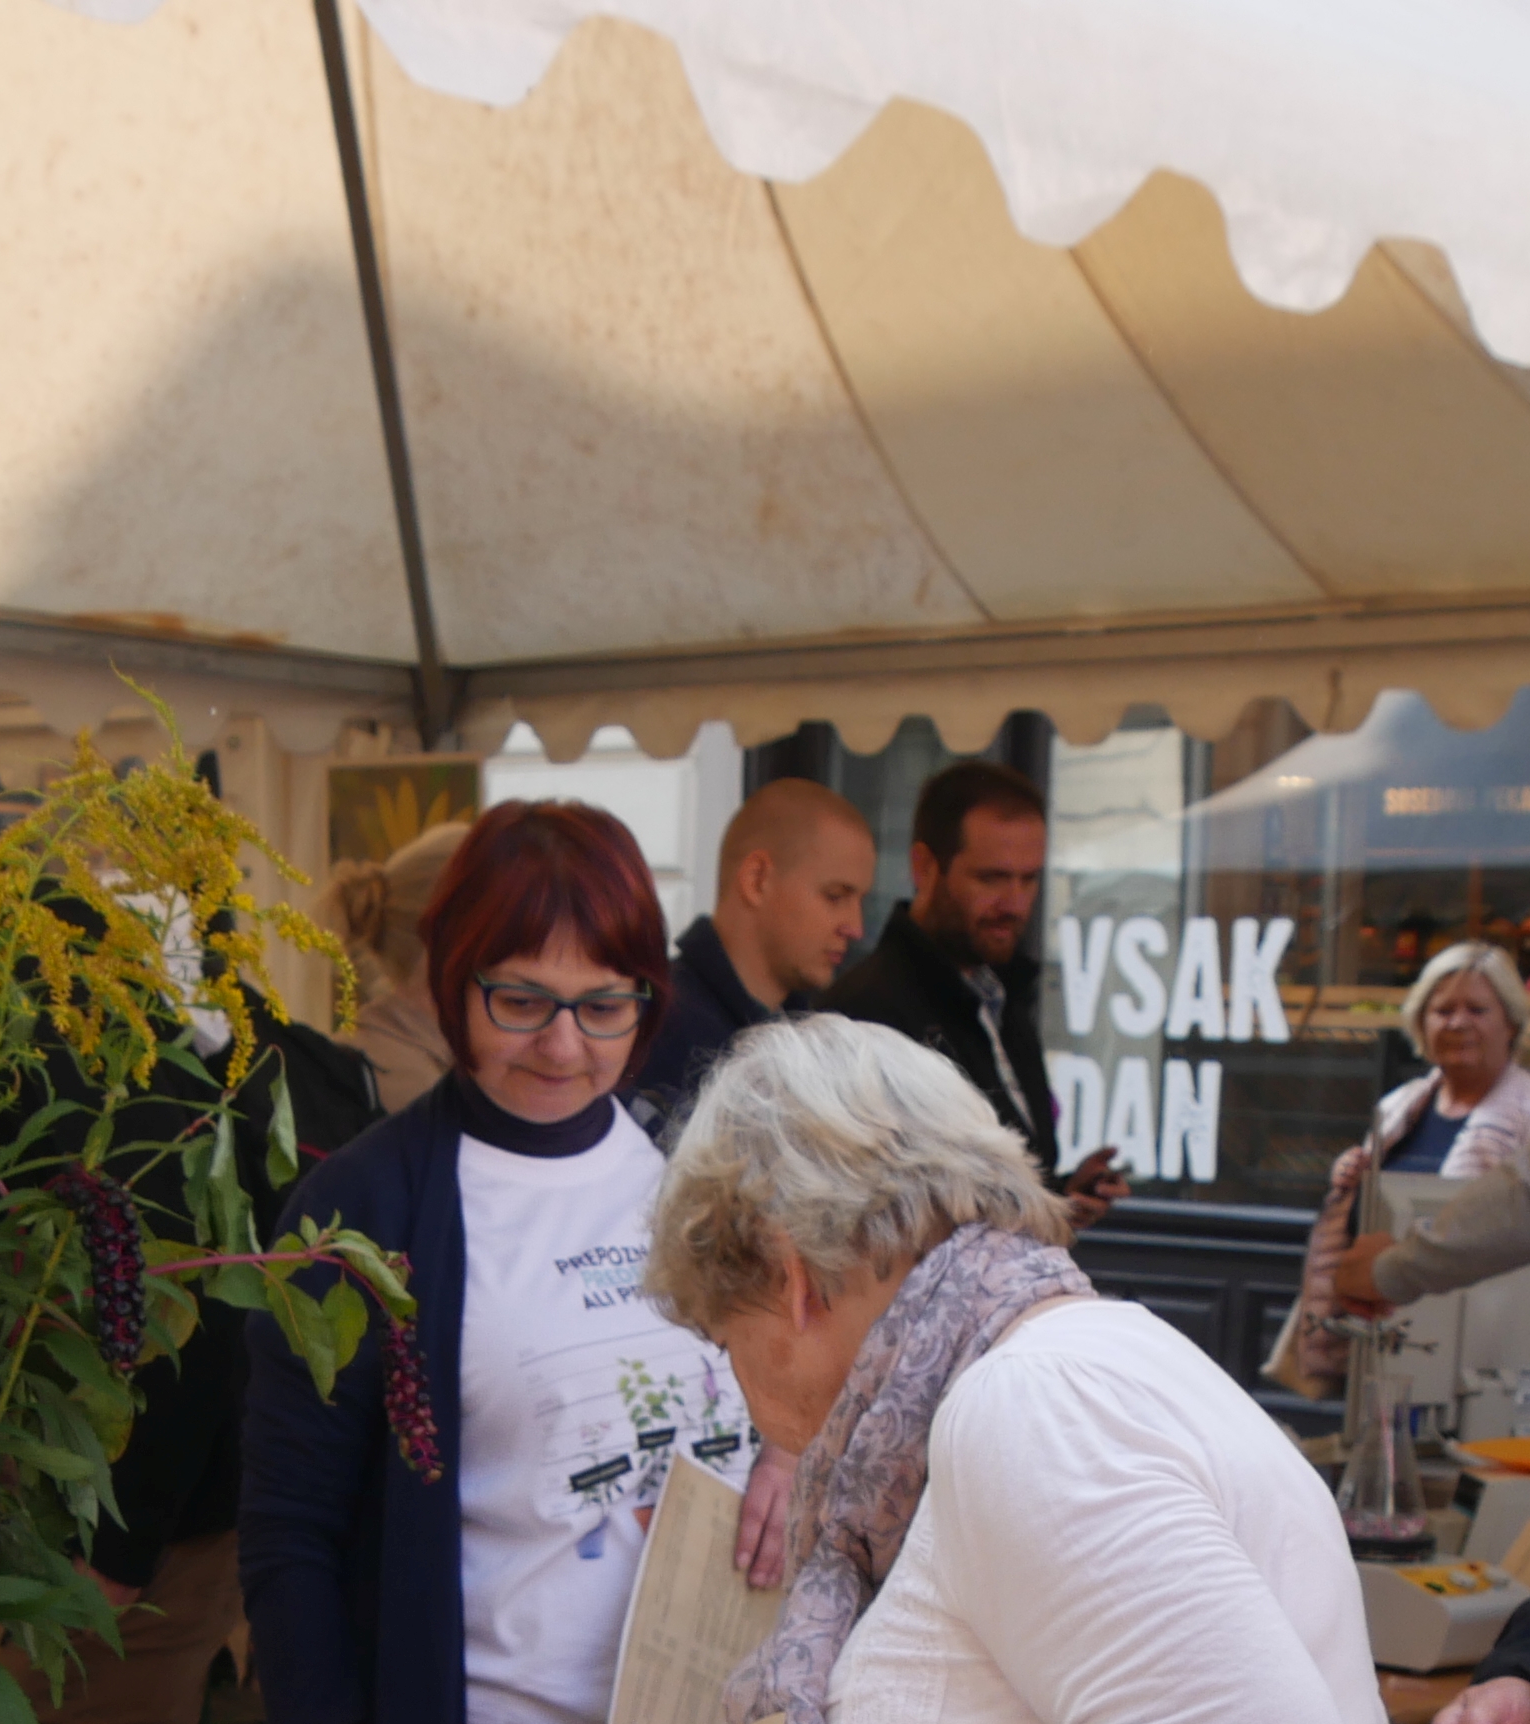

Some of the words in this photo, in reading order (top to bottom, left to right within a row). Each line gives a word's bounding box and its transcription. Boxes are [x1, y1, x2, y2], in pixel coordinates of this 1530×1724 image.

[1058, 917, 1294, 1043] VSAK
[1052, 1052, 1223, 1182] DAN
[584, 1289, 615, 1309] ALI
